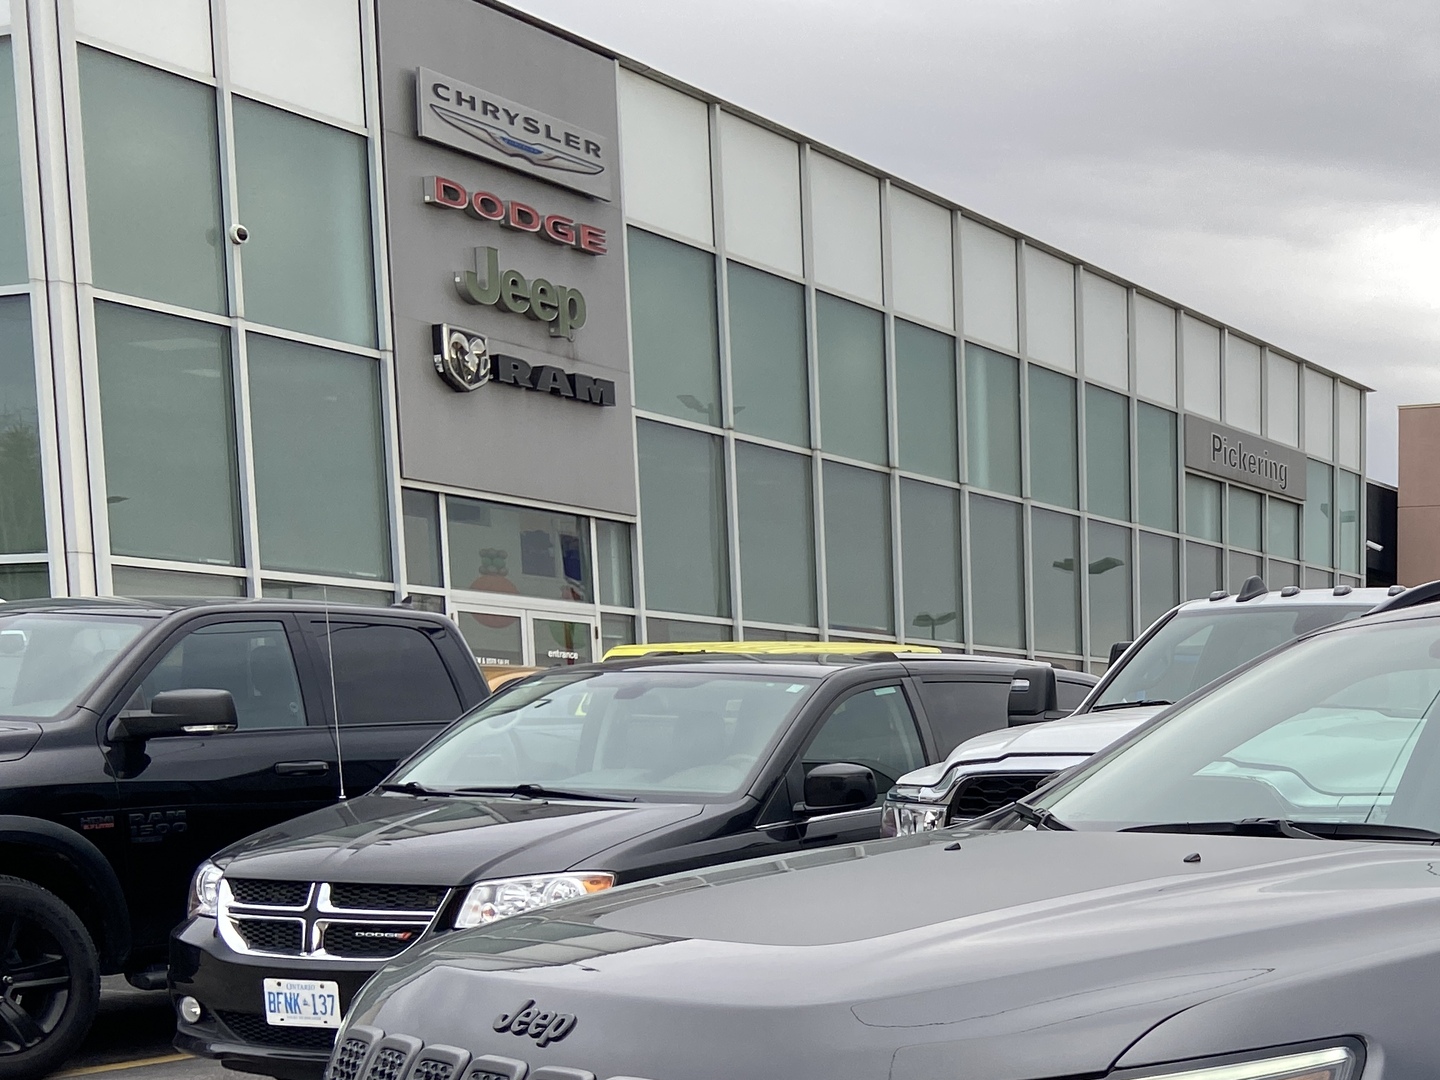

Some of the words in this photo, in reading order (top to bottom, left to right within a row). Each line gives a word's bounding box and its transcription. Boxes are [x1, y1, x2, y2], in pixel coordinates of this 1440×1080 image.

[431, 82, 602, 159] CHRYSLER
[426, 175, 608, 255] DODGE
[454, 246, 587, 342] Jeep
[494, 354, 616, 406] RAM
[1211, 432, 1288, 491] Pickering
[547, 649, 579, 660] entrance
[355, 931, 405, 939] DODGE
[268, 992, 302, 1015] BFNK
[311, 993, 335, 1016] 137
[286, 983, 316, 991] ONTARIO
[492, 999, 578, 1048] Jeep
